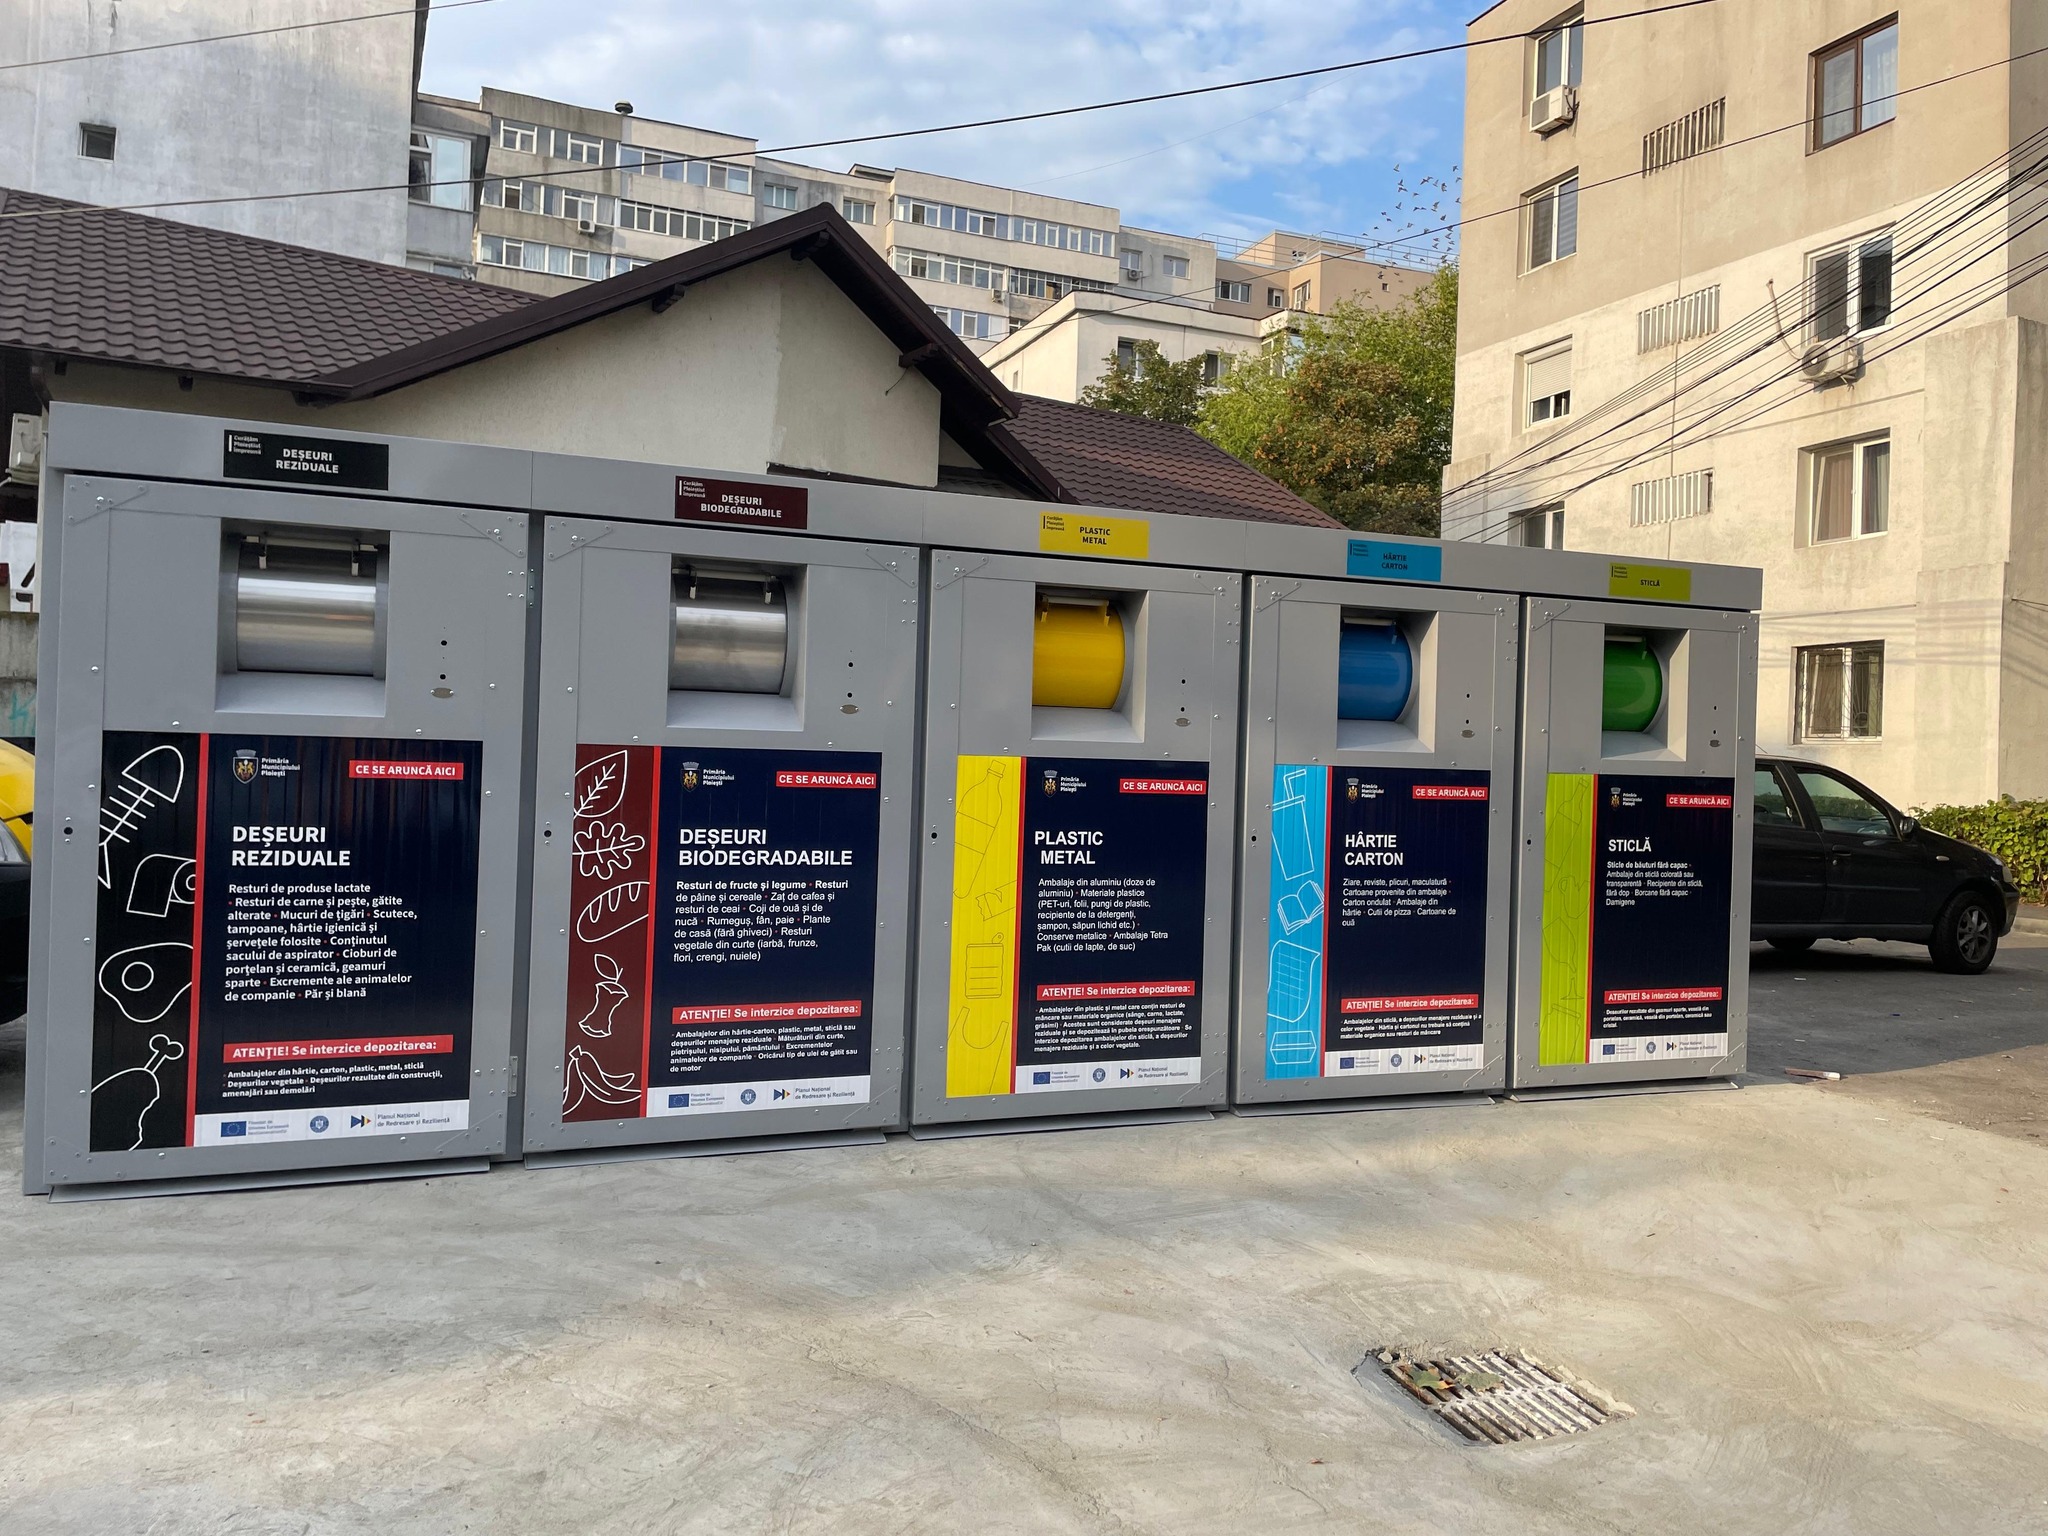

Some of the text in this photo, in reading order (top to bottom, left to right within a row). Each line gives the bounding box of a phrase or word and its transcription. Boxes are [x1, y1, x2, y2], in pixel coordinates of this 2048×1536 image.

[282, 448, 333, 461] DEȘEURI
[276, 460, 338, 473] REZIDUALE
[721, 494, 762, 506] DEȘEURI
[701, 503, 781, 518] BIODEGRADABILE
[1080, 527, 1110, 535] PLASTIC
[1083, 536, 1107, 545] METAL
[1383, 552, 1406, 561] HÂRTIE
[1382, 562, 1408, 570] CARTON
[262, 758, 289, 766] Primăria
[356, 765, 455, 776] CE SE ARUNCĂ AICI
[779, 775, 874, 785] CE SE ARUNCĂ AICI
[1123, 782, 1134, 790] CE
[1137, 782, 1148, 790] SE
[1149, 782, 1185, 791] ARUNCĂ
[1438, 788, 1469, 797] ARUNCĂ
[1689, 797, 1715, 805] ARUNCĂ
[233, 826, 325, 847] DEȘEURI
[680, 829, 766, 849] DEȘEURI
[1035, 831, 1103, 845] PLASTIC
[1346, 831, 1396, 847] HÂRTIE
[1609, 837, 1651, 852] STICLĂ
[232, 850, 350, 866] REZIDUALE
[679, 849, 852, 865] BIODEGRADABILE
[1041, 850, 1095, 864] METAL
[1345, 852, 1403, 865] CARTON
[229, 883, 370, 895] Resturi de produse lactate
[677, 880, 848, 891] Resturi de fructe și legume Resturi
[1038, 878, 1155, 888] Ambalaje din aluminiu (doze de
[1343, 879, 1362, 887] Ziare,
[1389, 878, 1410, 887] plicuri,
[676, 892, 834, 903] de pâine și cereale Zaț de cafea și
[1038, 889, 1145, 898] aluminiu) Materiale plastice
[235, 897, 274, 906] Resturi
[277, 897, 291, 906] de
[326, 896, 334, 908] și
[338, 897, 369, 908] pește,
[372, 896, 402, 907] gătite
[675, 903, 823, 914] resturi de ceai Coji de ouă și de
[228, 909, 417, 921] alterate Mucuri de țigări Scutece,
[227, 922, 377, 935] tampoane, hârtie igienică și
[227, 935, 387, 949] șervețele folosite Conținutul
[226, 948, 397, 961] sacului de aspirator Cioburi de
[226, 961, 385, 976] porțelan și ceramică, geamuri
[225, 973, 412, 989] sparte Excremente ale animalelor
[225, 987, 366, 1002] de companie Păr și blană
[1042, 985, 1190, 998] ATENȚIE! Se interzice depozitarea:
[1608, 992, 1640, 1002] ATENȚIE!
[1641, 992, 1650, 1000] Se
[1680, 991, 1718, 1000] depozitarea:
[1346, 998, 1473, 1011] ATENȚIE! Se interzice depozitarea:
[680, 1005, 858, 1021] ATENȚIE! Se interzice depozitarea:
[233, 1041, 436, 1059] ATENȚIE! Se interzice depozitarea:
[228, 1069, 276, 1078] Ambalajelor
[292, 1067, 318, 1075] hârtie,
[349, 1065, 377, 1073] plastic,
[378, 1063, 402, 1071] metal,
[222, 1088, 263, 1097] amenajări
[280, 1086, 315, 1094] demolări
